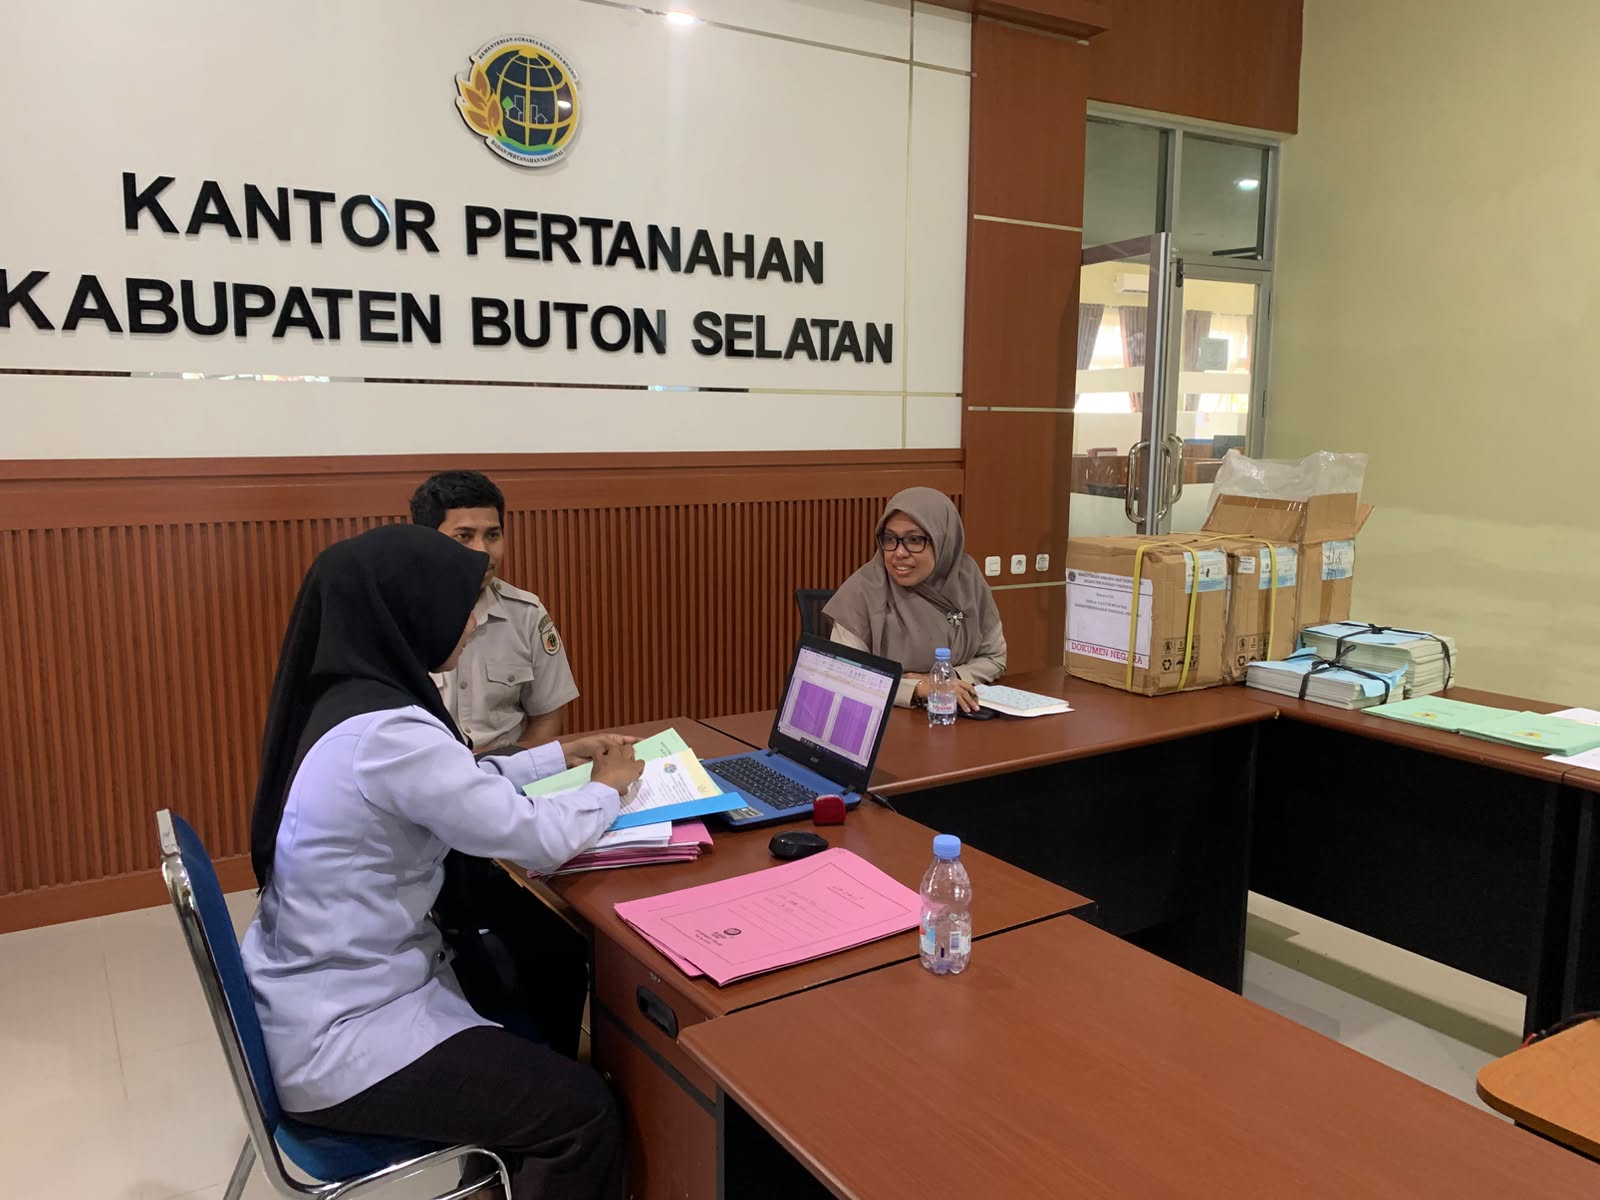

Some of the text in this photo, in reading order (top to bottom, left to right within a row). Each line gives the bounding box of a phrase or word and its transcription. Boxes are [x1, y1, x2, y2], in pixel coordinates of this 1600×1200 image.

[122, 171, 824, 285] KANTOR PERTANAHAN
[0, 268, 893, 364] KABUPATEN BUTON SELATAN
[1071, 641, 1108, 657] DOKUMEN
